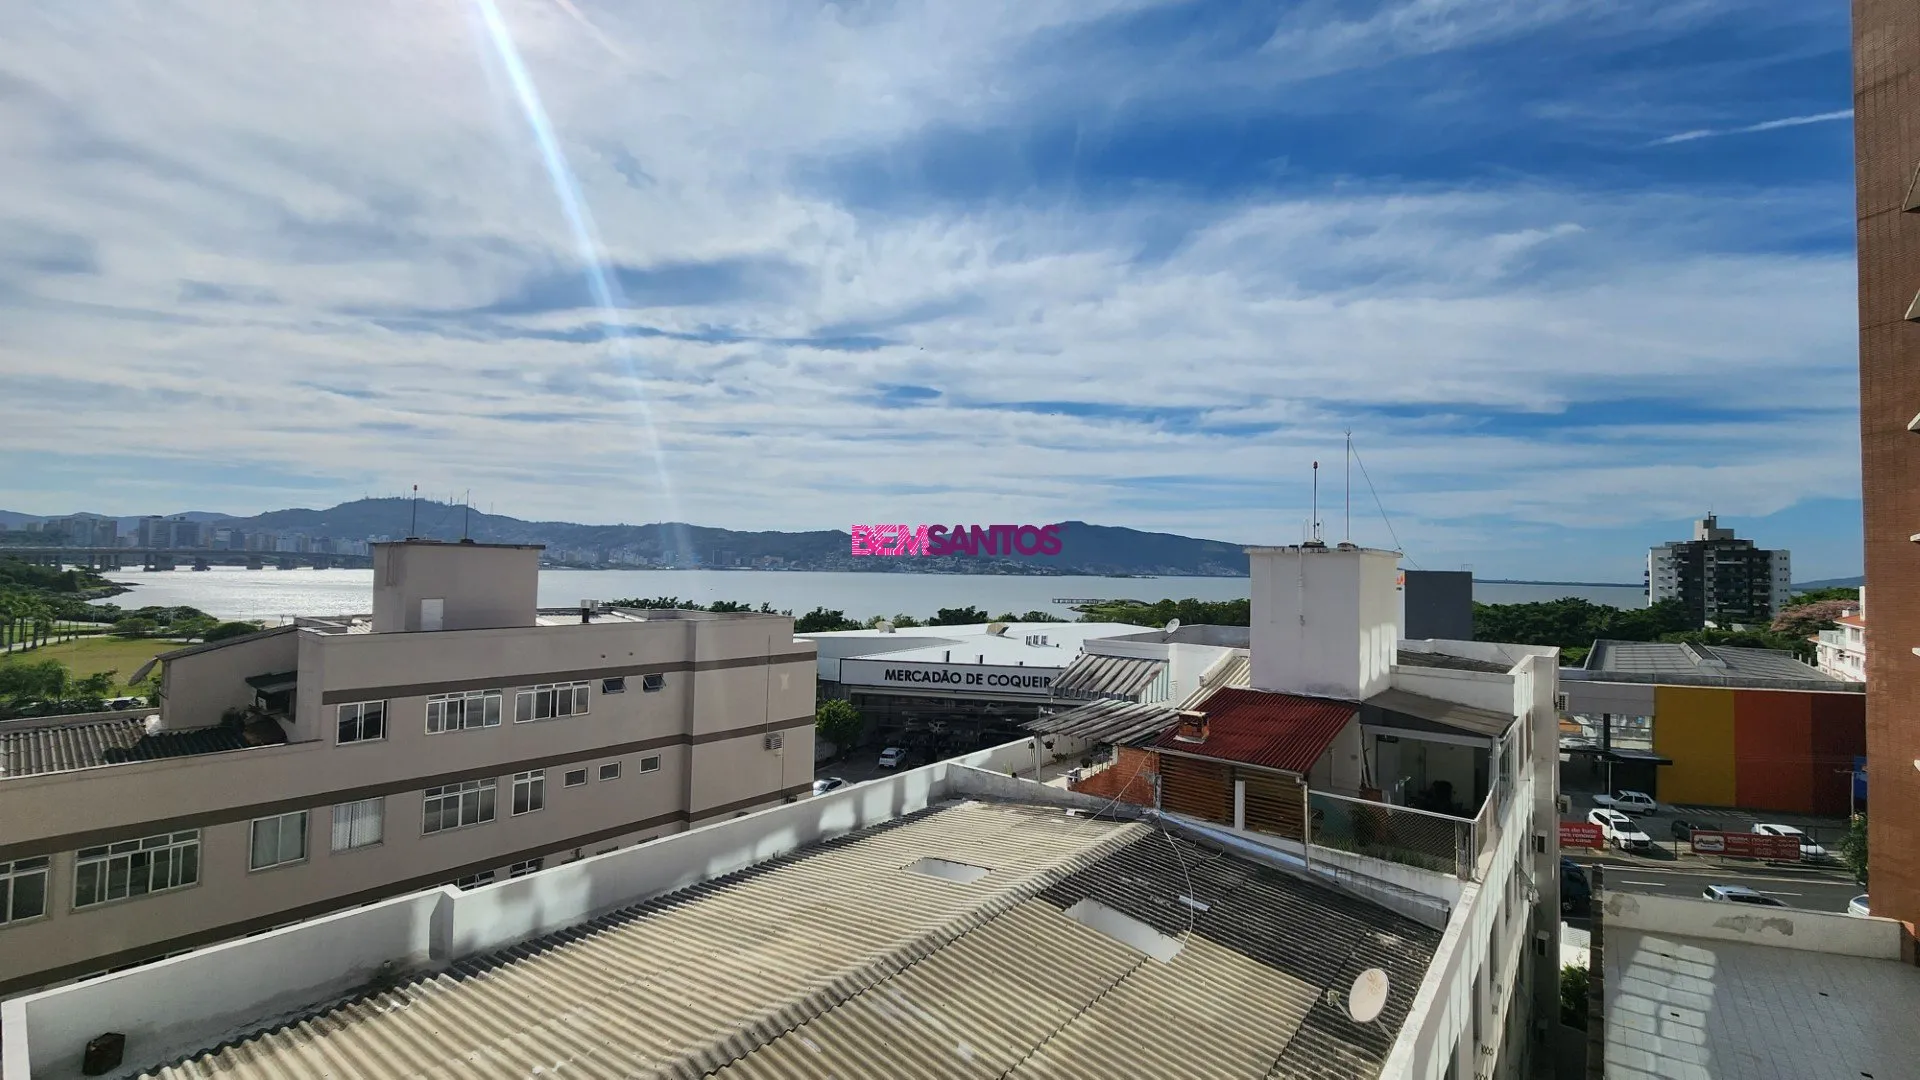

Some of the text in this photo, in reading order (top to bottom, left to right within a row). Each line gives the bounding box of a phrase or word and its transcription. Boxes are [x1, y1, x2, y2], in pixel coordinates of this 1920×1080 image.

[884, 669, 1057, 689] MERCADÃO DE COQUEIR
